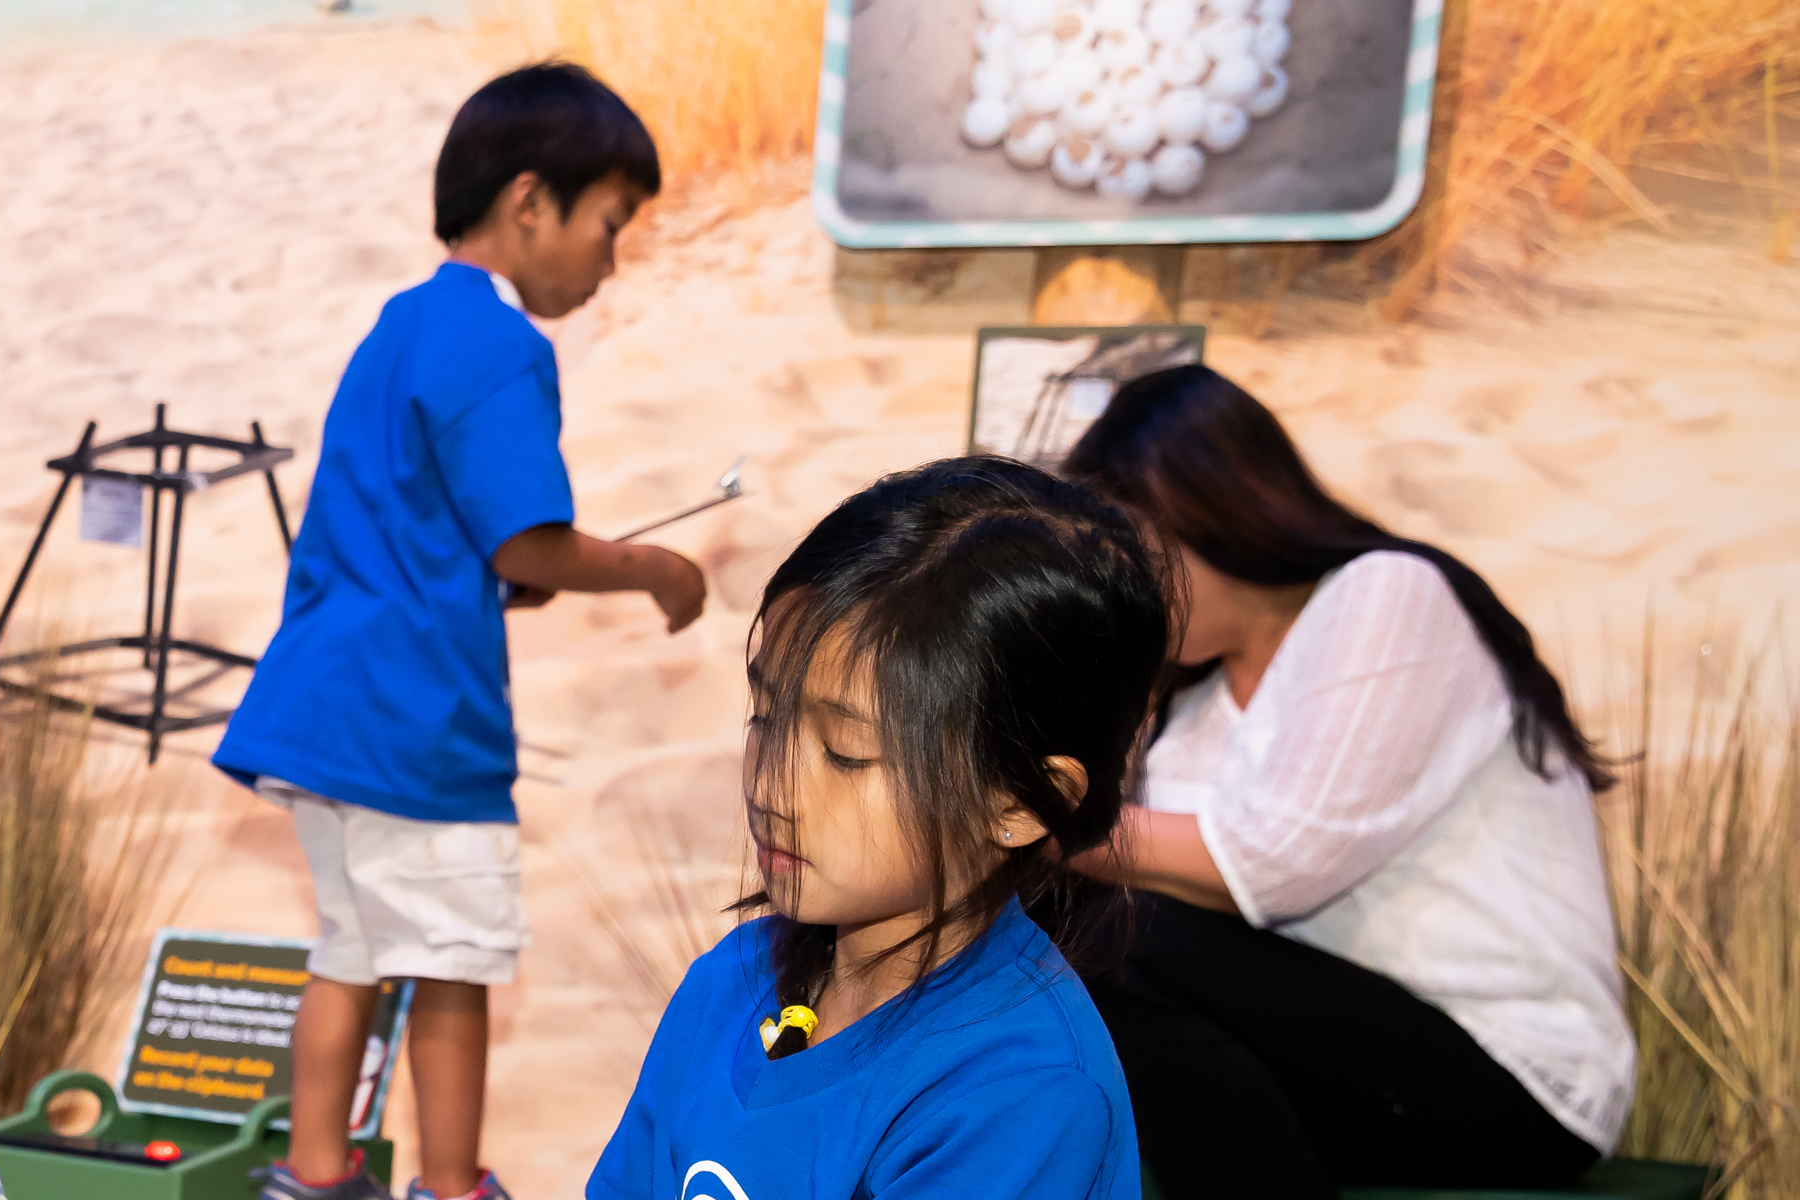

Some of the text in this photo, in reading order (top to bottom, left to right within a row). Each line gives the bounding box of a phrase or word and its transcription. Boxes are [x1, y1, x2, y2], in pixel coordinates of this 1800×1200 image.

[214, 962, 248, 981] and
[139, 1044, 199, 1070] Record
[196, 1055, 234, 1076] your
